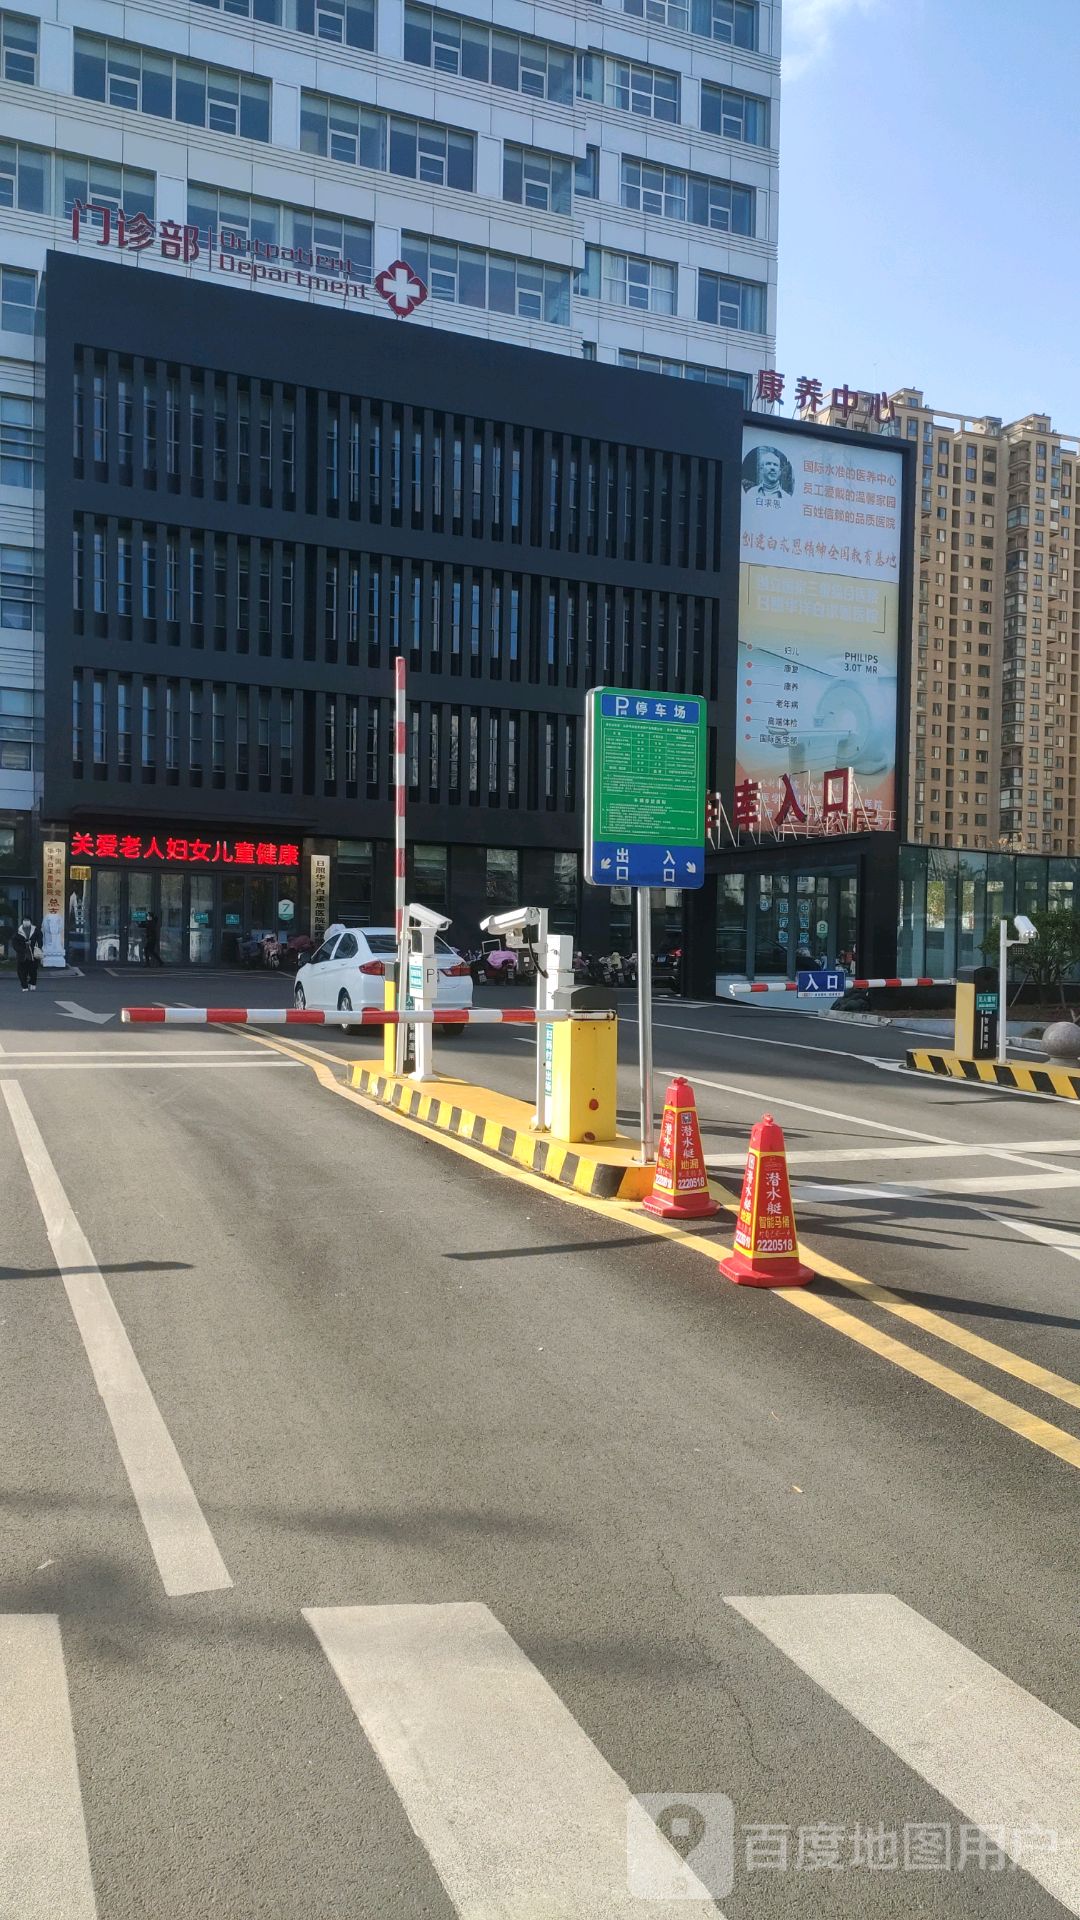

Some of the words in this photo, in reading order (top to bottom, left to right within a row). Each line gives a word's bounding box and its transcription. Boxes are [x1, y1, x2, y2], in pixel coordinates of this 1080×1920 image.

[72, 199, 200, 264] 门诊部
[219, 229, 353, 273] Outpatient
[219, 253, 369, 299] Department
[758, 369, 896, 424] 康养中心
[803, 459, 897, 487] 国际水准的医养中心
[755, 497, 782, 510] 白求恩
[802, 503, 896, 530] 百姓信赖的品质医院
[844, 651, 879, 664] PHILIPS
[844, 663, 862, 673] 3.0T
[865, 665, 878, 674] MR
[635, 701, 686, 720] 停车场
[71, 831, 299, 866] 关爱老人妇女儿童健康
[616, 847, 629, 881] 出口
[662, 850, 676, 883] 入口
[282, 903, 291, 913] 7
[804, 973, 839, 991] 入口
[681, 1125, 695, 1158] 潜水艇
[680, 1158, 699, 1170] 地漏
[677, 1176, 705, 1189] 2220518
[765, 1172, 783, 1215] 潜水艇
[759, 1216, 790, 1229] 智能马桶
[756, 1239, 793, 1252] 2220518
